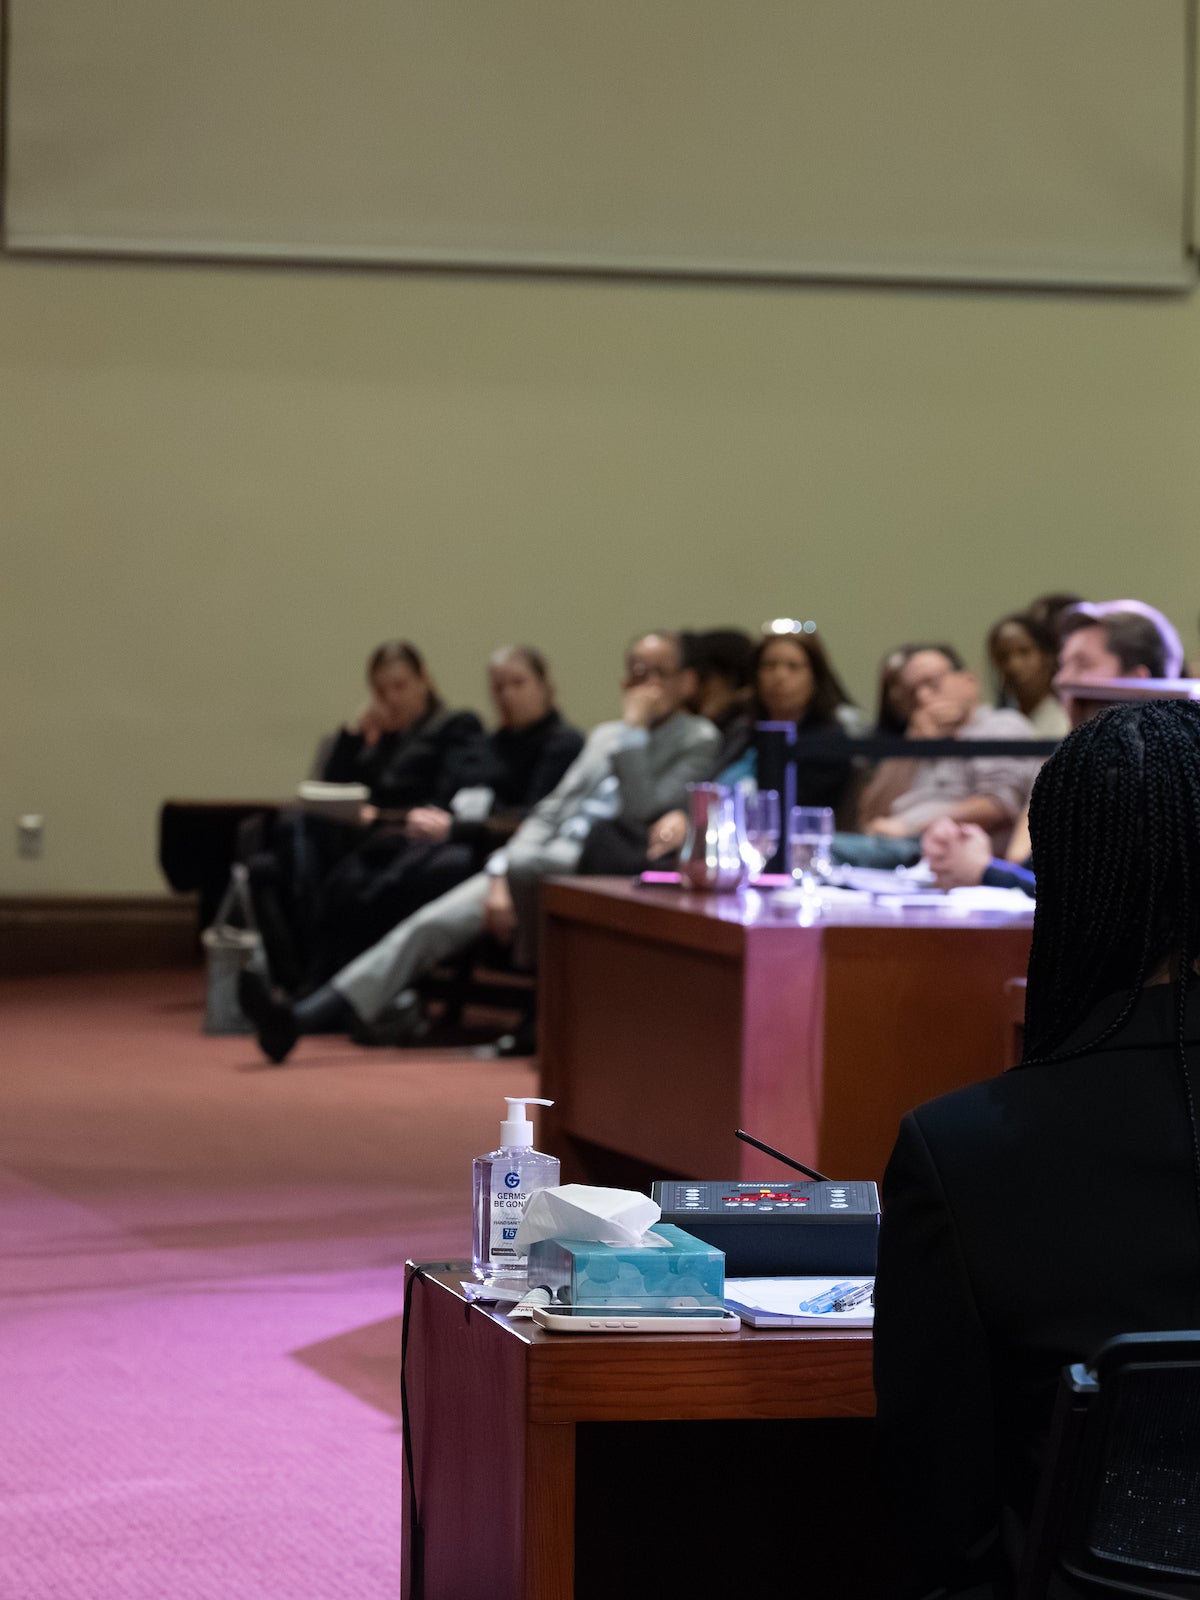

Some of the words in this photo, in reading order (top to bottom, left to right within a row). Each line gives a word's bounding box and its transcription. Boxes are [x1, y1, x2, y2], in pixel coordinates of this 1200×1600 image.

[497, 1192, 526, 1200] GERMS
[494, 1200, 505, 1208] BE
[505, 1200, 525, 1208] GON
